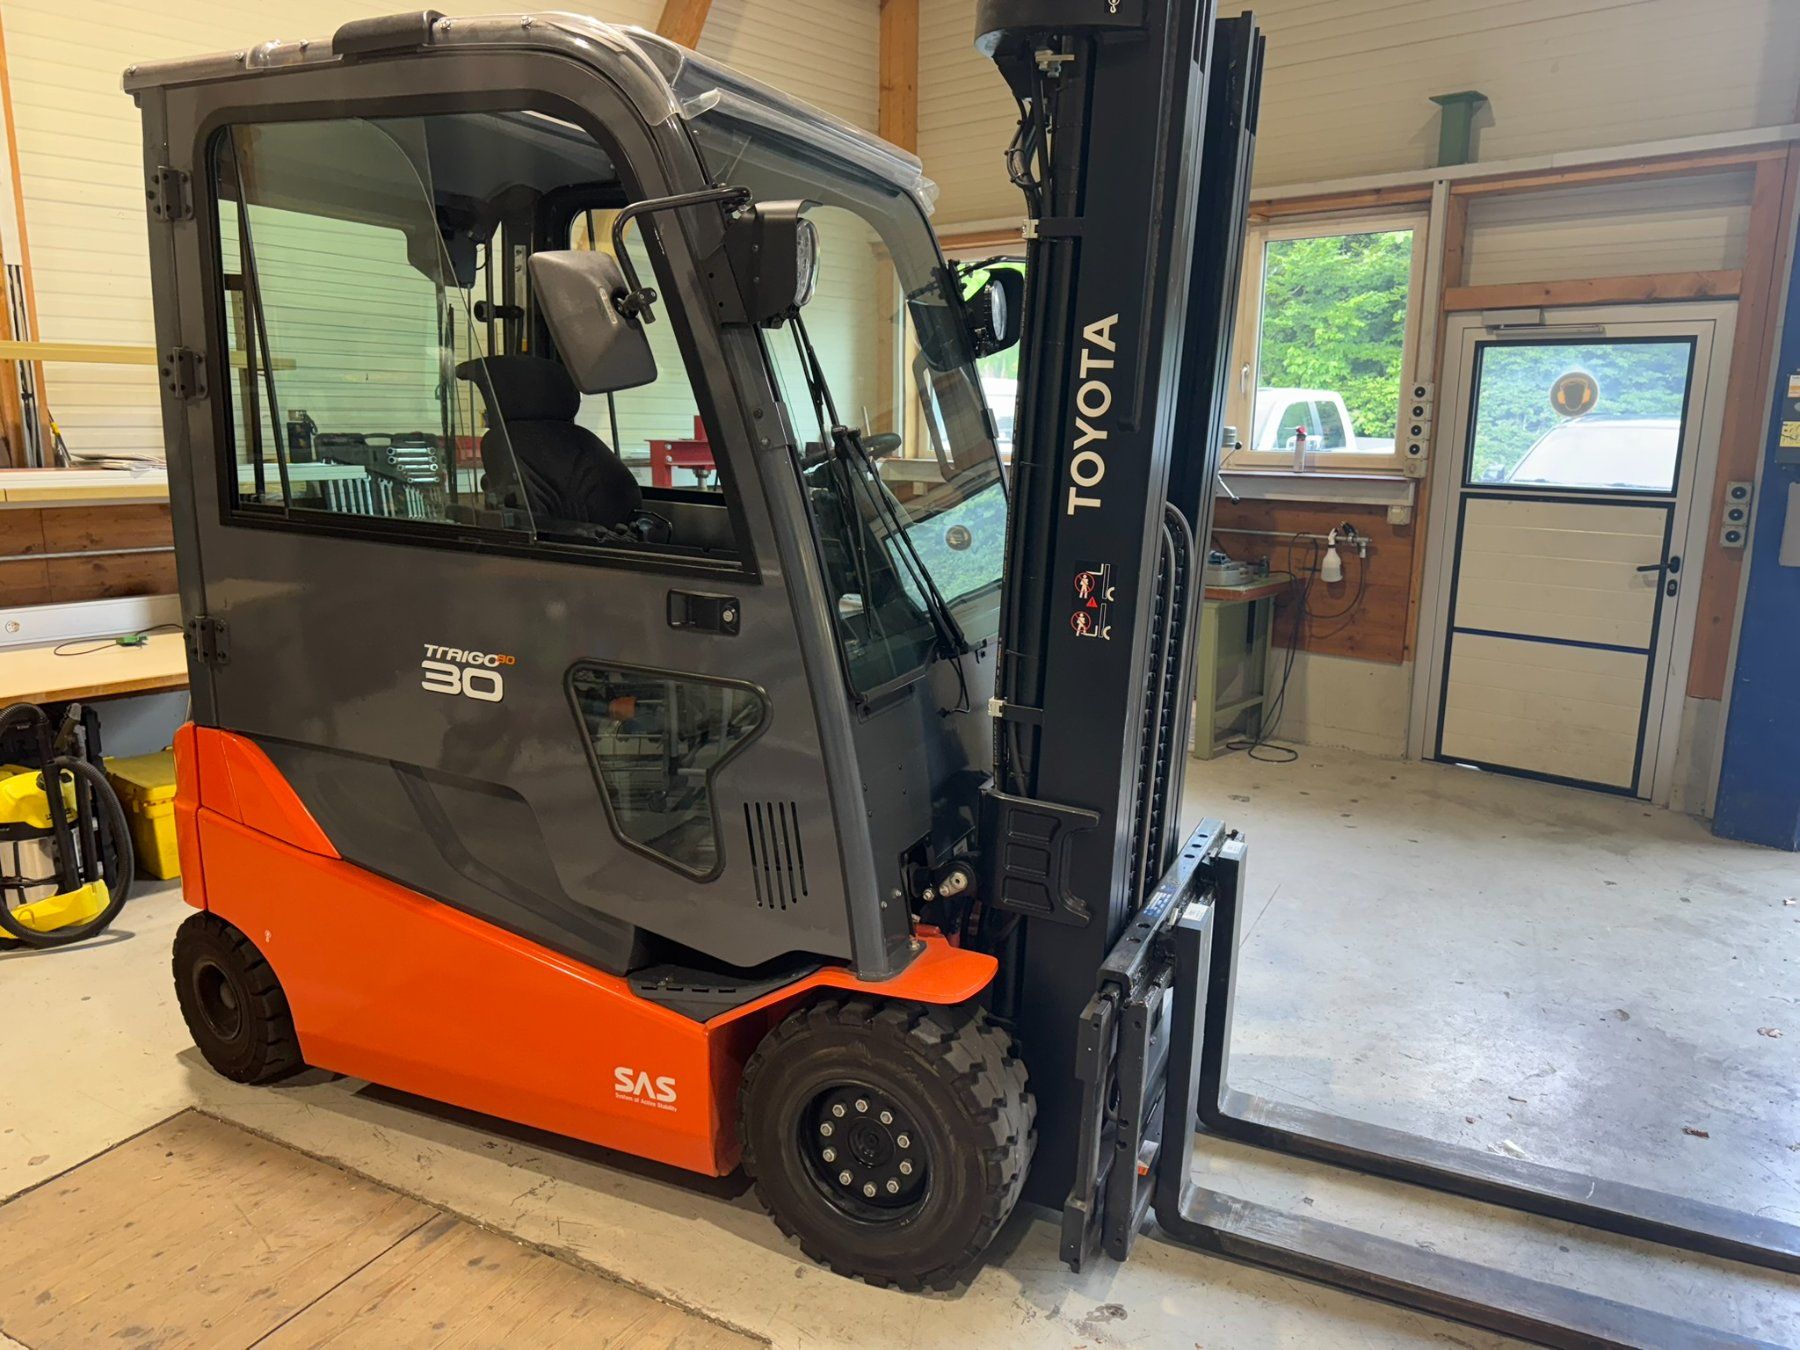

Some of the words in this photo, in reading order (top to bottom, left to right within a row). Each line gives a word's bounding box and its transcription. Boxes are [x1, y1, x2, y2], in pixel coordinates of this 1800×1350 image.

[1067, 313, 1119, 515] TOYOTA
[421, 660, 504, 703] 30
[614, 1066, 677, 1103] SAS
